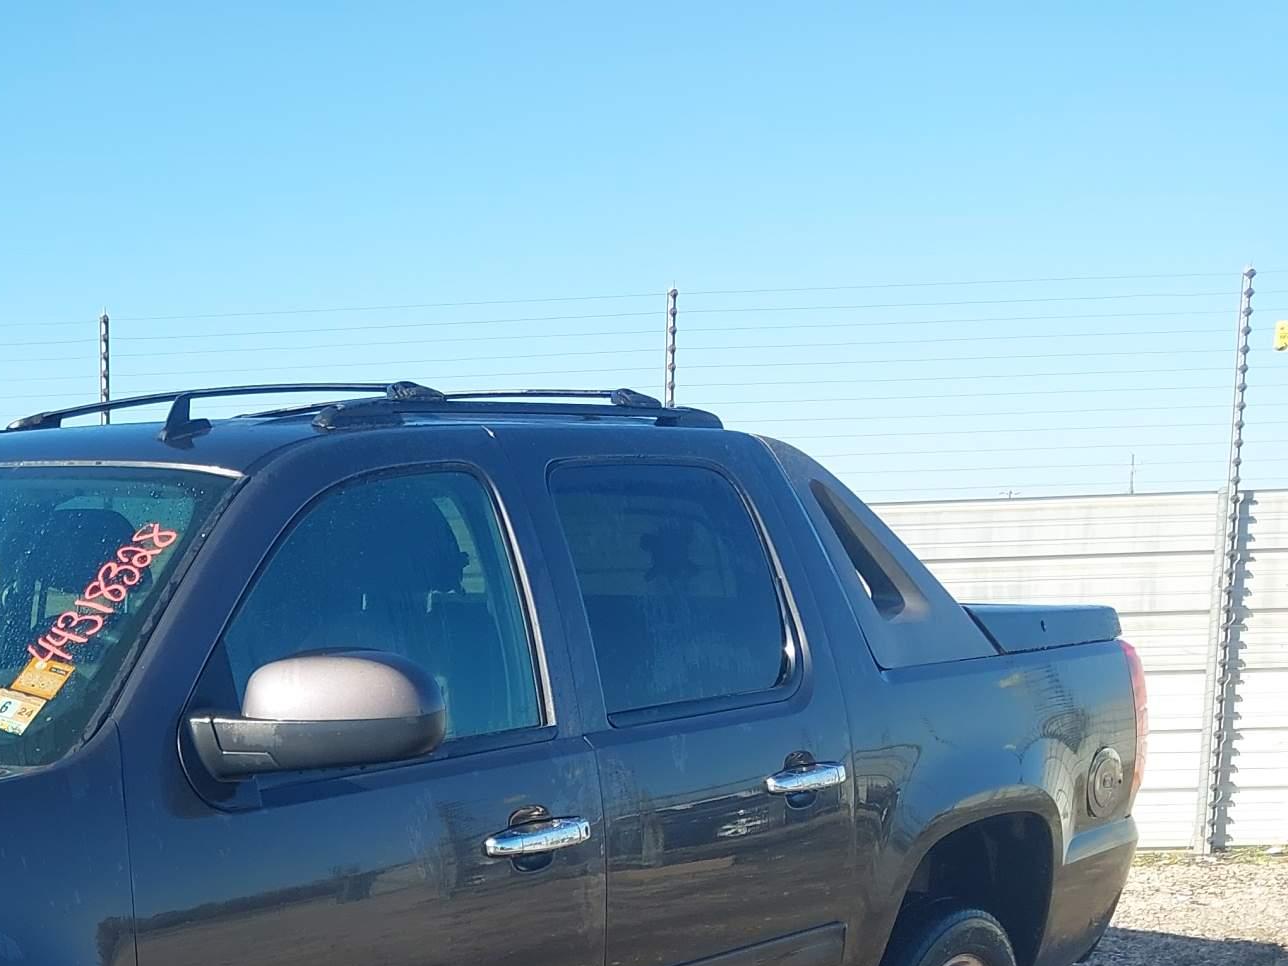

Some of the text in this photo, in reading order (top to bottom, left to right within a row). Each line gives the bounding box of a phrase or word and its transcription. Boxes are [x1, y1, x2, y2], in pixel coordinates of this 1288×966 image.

[28, 523, 177, 661] 44318328
[0, 700, 12, 714] 6
[17, 707, 34, 718] 24
